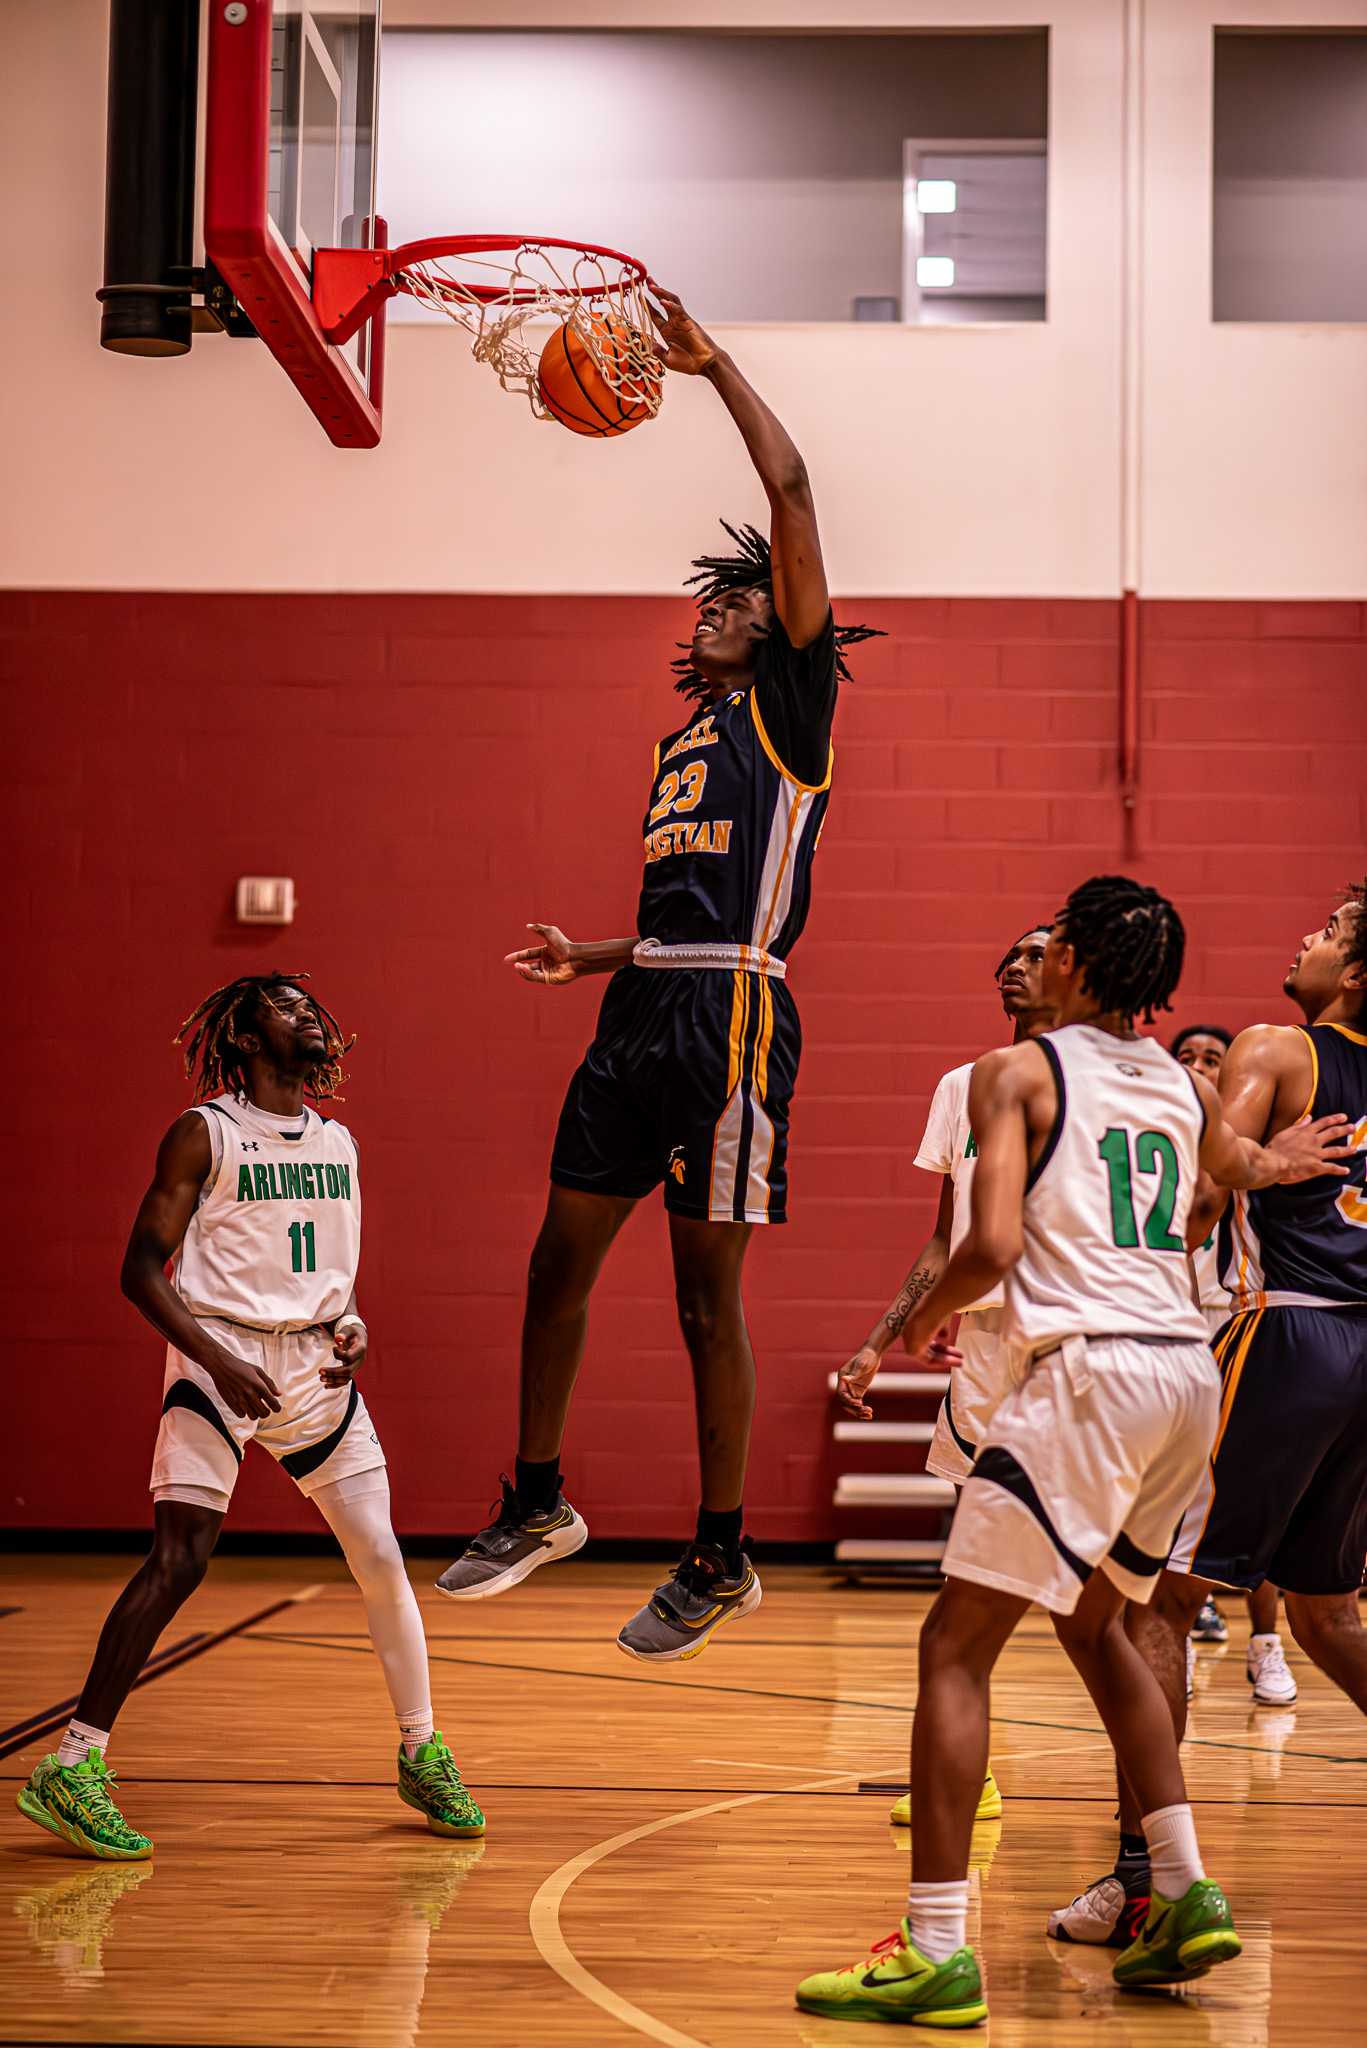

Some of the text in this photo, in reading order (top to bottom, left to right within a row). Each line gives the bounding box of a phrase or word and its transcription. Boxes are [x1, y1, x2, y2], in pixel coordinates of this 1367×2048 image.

[649, 760, 708, 827] 23
[237, 1163, 351, 1202] ARLINGTON
[1098, 1127, 1186, 1252] 12
[288, 1221, 316, 1272] 11
